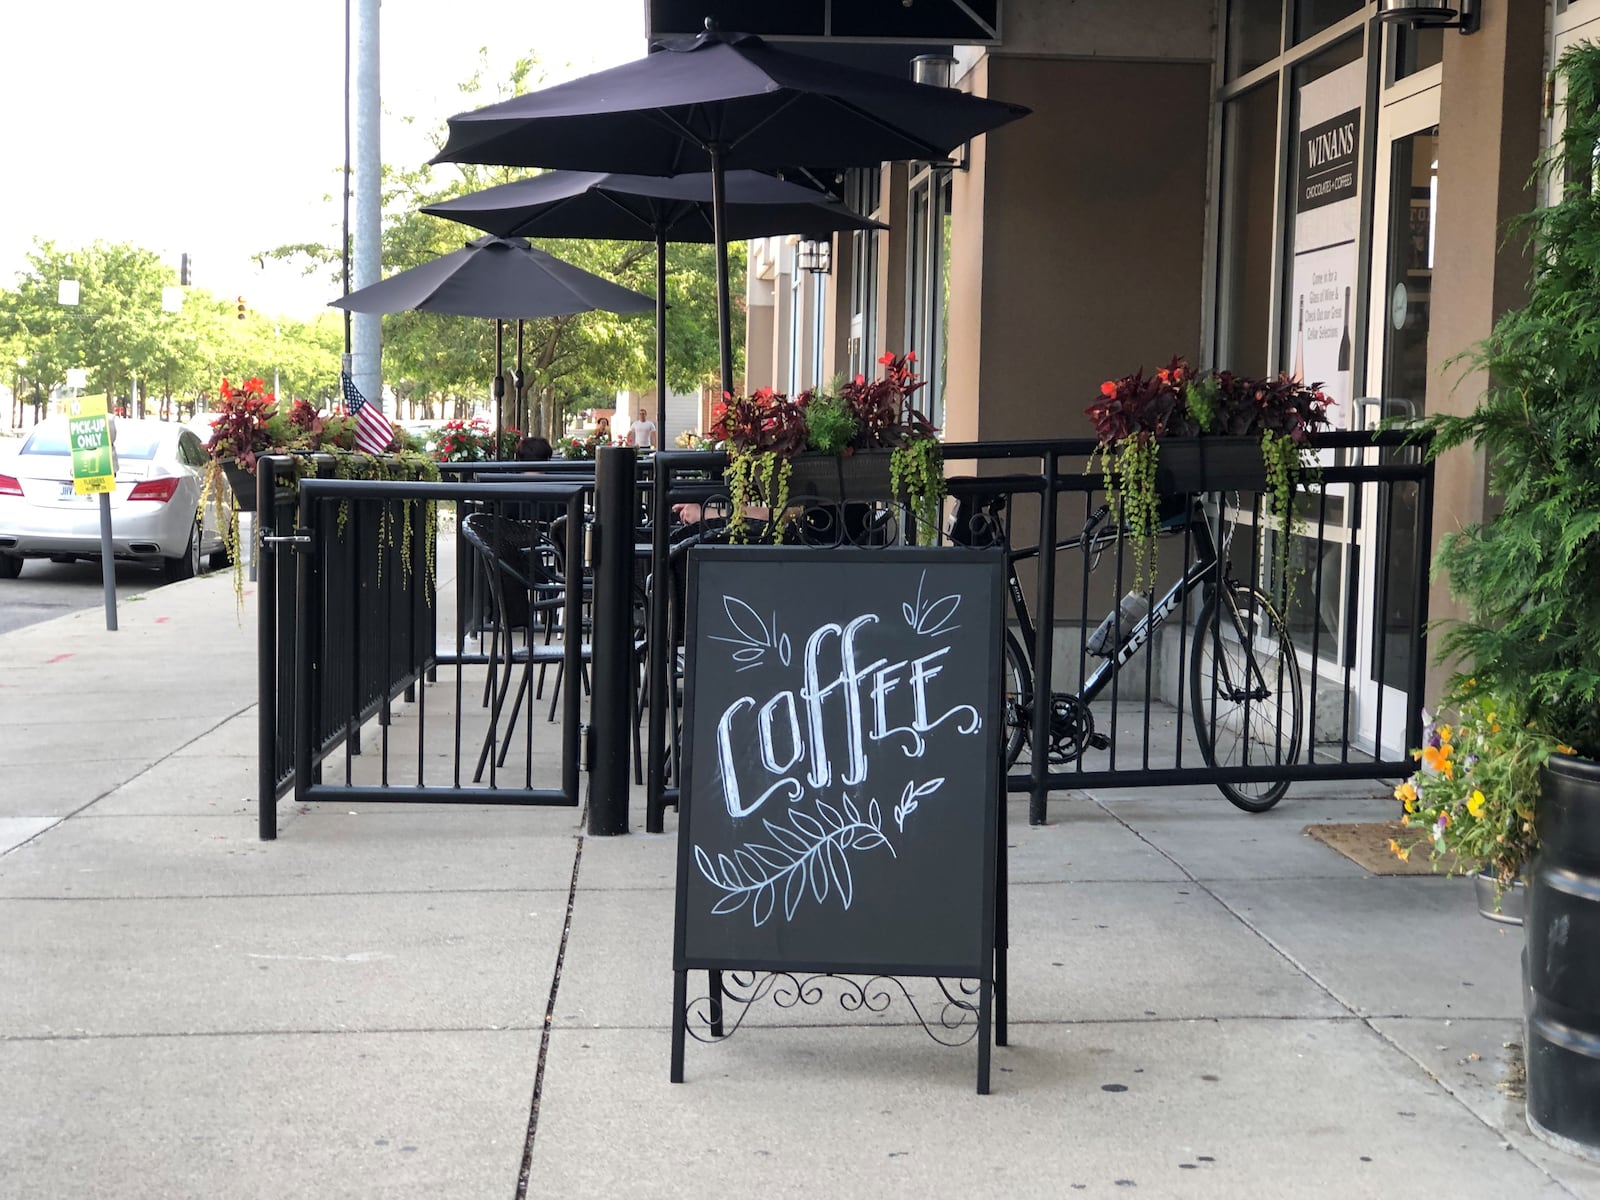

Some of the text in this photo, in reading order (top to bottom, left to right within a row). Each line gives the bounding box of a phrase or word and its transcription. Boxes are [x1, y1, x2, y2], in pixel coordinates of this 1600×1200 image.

[1308, 122, 1354, 169] WINANS
[1305, 180, 1332, 200] CHOCOLATES
[1334, 172, 1353, 190] COFFEES
[70, 418, 106, 435] PICK-UP
[77, 433, 103, 448] ONLY
